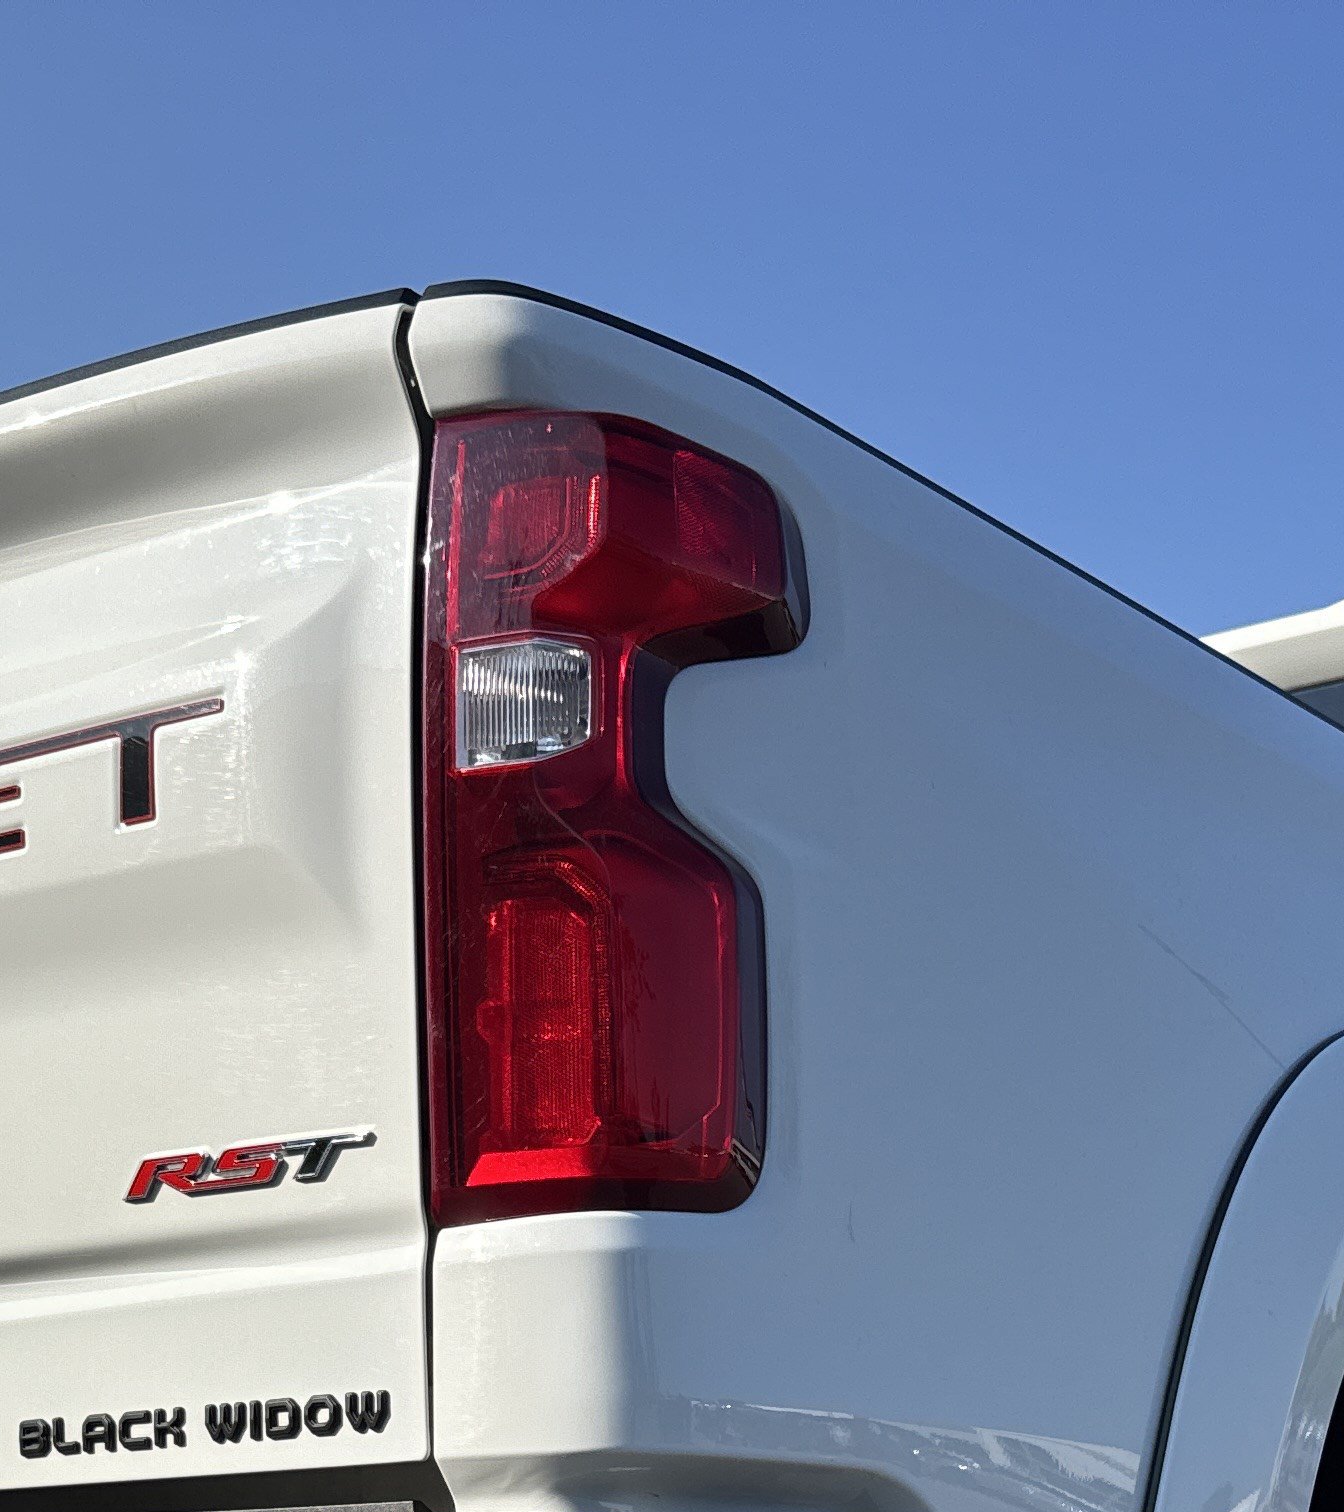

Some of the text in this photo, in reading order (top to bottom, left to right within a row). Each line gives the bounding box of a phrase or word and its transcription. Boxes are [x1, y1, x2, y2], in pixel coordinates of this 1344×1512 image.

[122, 1127, 377, 1203] RST
[19, 1390, 391, 1459] BLACK WIDOW
